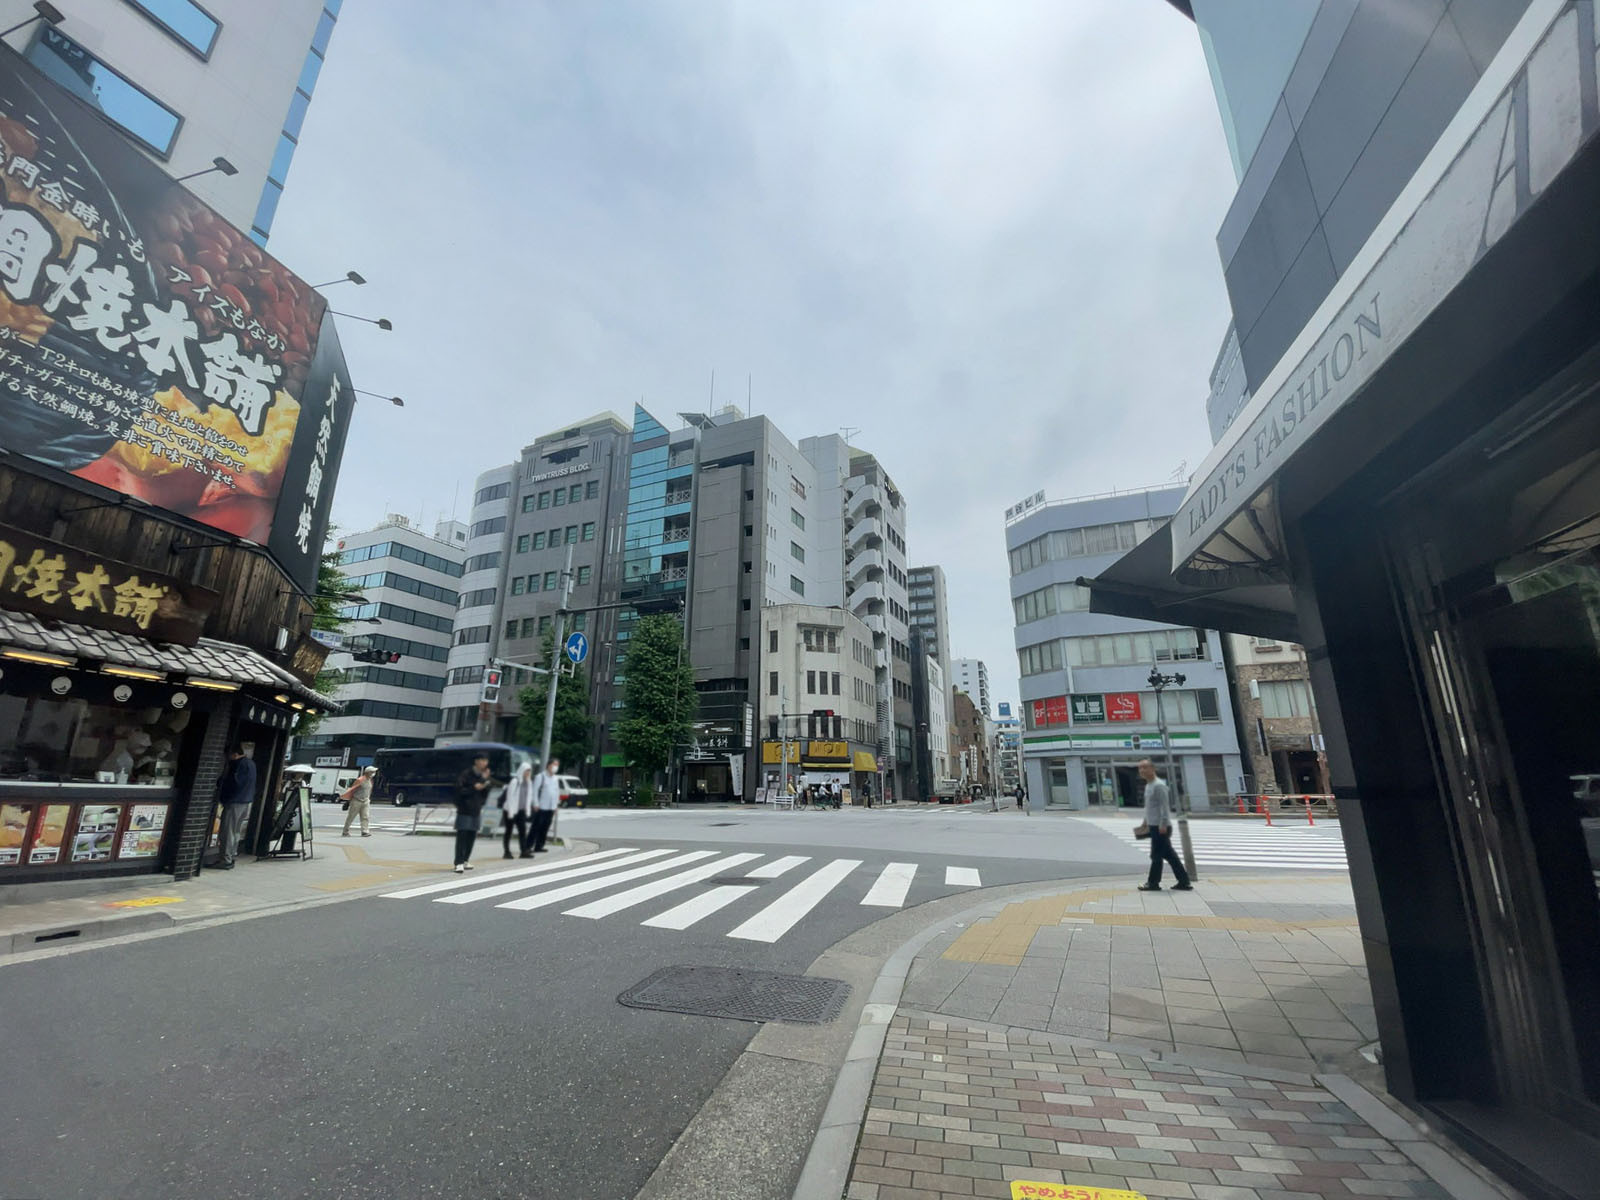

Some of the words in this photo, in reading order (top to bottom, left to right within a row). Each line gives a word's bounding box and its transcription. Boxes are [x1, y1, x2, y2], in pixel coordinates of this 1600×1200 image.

[0, 143, 146, 263] 門金時いも
[168, 265, 286, 352] アイスもなか
[1188, 452, 1248, 538] LADY'S
[1253, 291, 1385, 471] FASHION
[531, 467, 569, 483] TWINTRUSS
